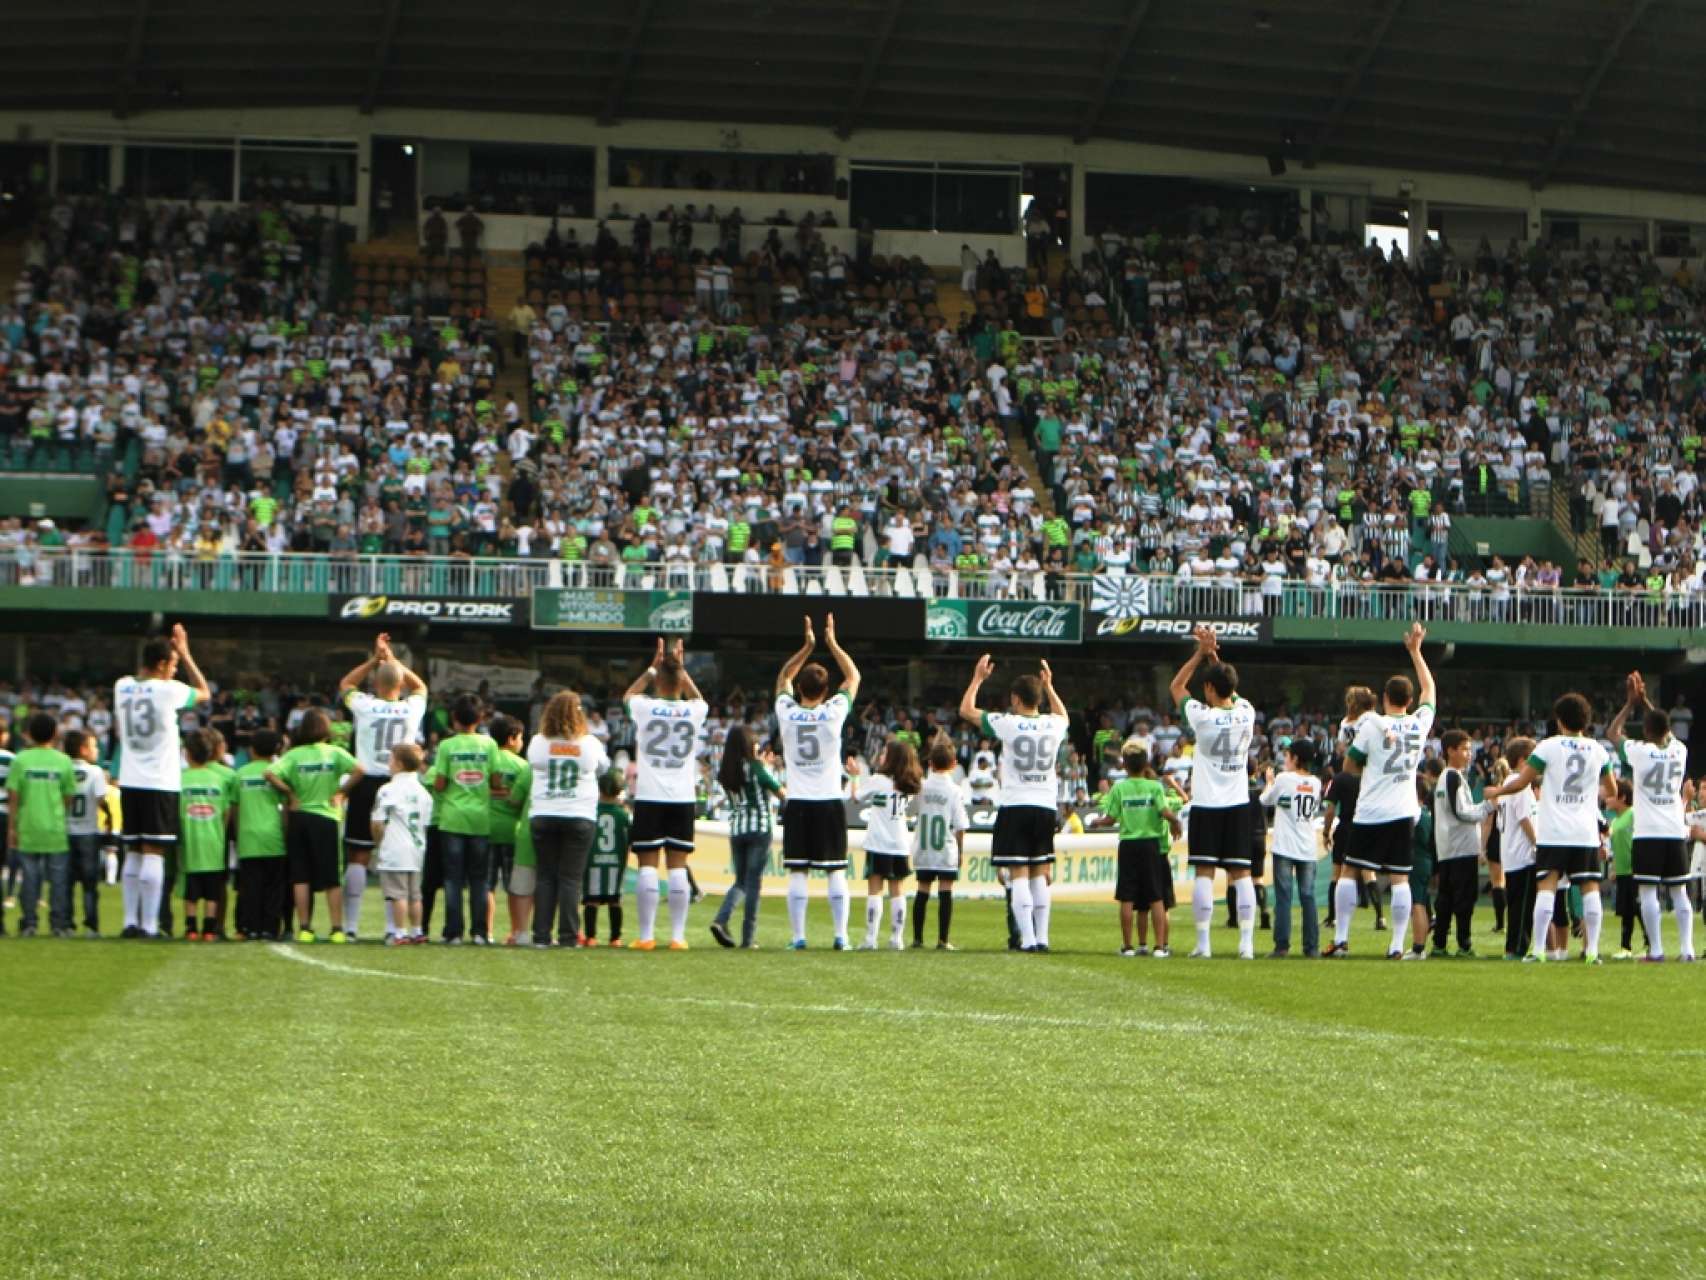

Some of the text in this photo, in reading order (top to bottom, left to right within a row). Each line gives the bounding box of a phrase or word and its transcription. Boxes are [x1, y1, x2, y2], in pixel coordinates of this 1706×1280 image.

[386, 600, 514, 618] PRO TORK
[977, 604, 1071, 636] Coca-Cola
[1140, 619, 1192, 633] PRO
[120, 698, 155, 738] 13
[645, 720, 695, 759] 23
[797, 724, 819, 761] 5
[1013, 734, 1056, 771] 99
[1383, 732, 1420, 774] 25
[1563, 754, 1586, 794] 2
[1643, 761, 1681, 795] 45
[1294, 794, 1314, 818] 10
[598, 814, 616, 851] 3
[920, 814, 946, 850] 10
